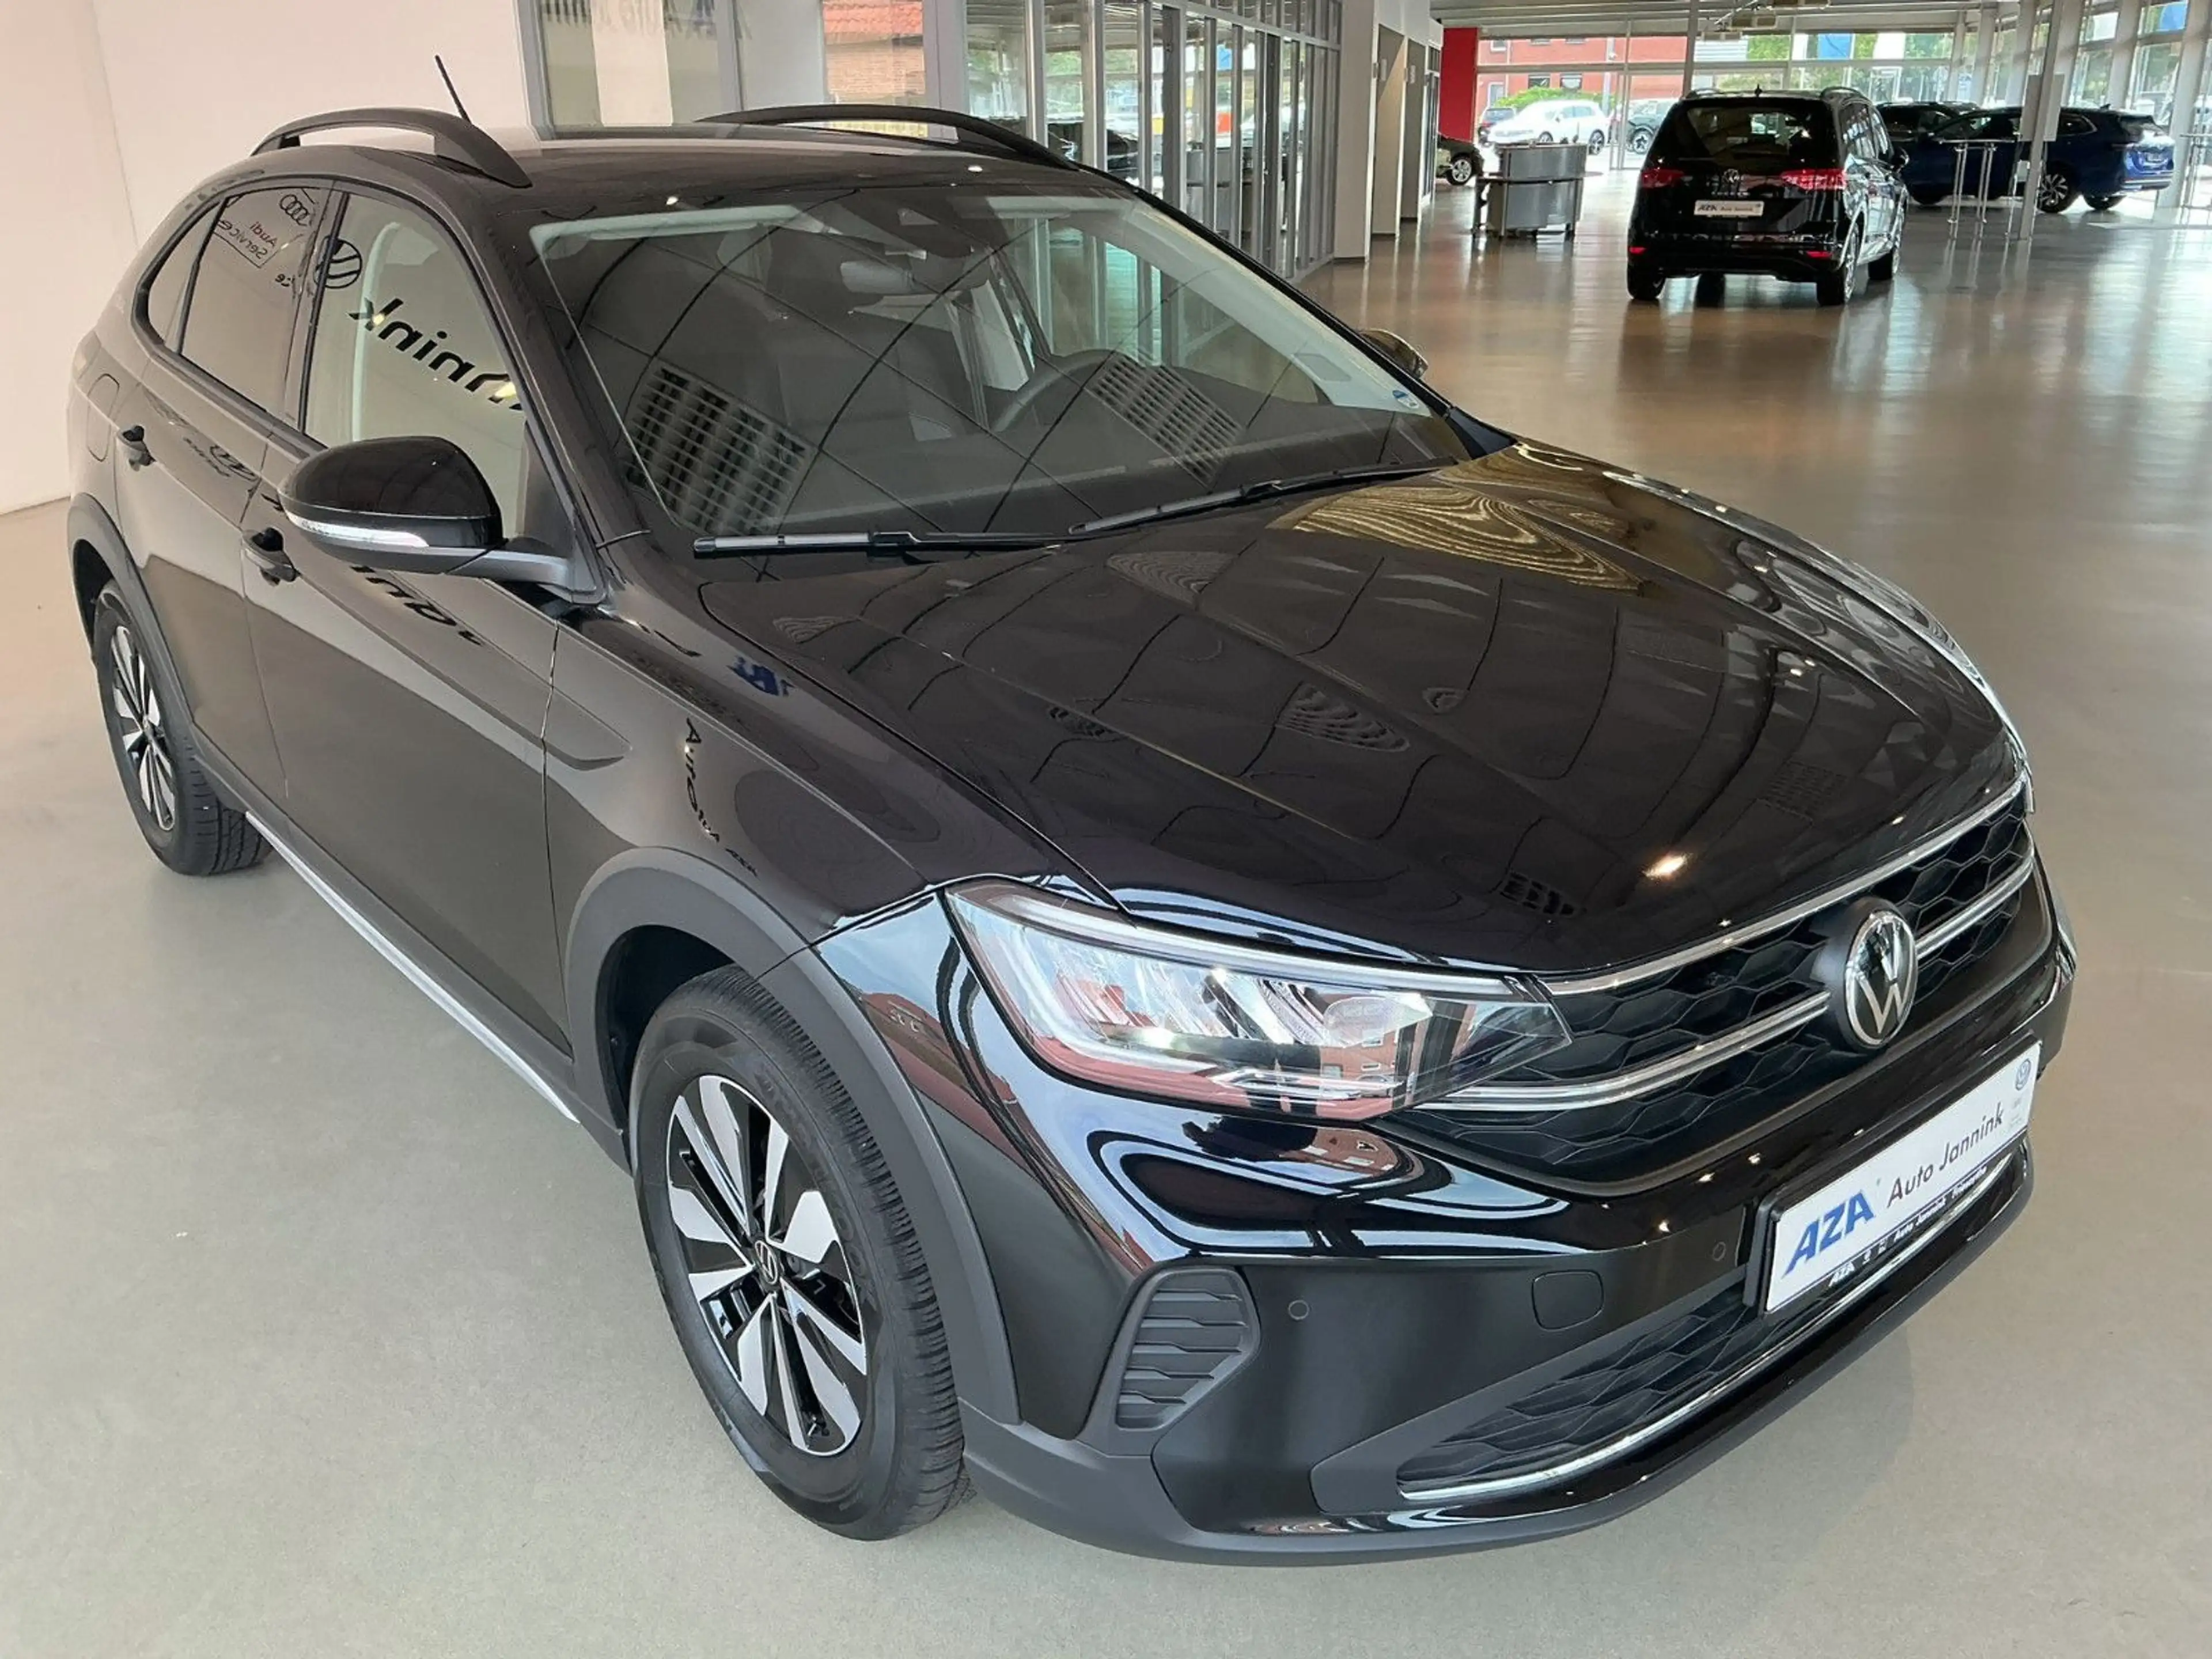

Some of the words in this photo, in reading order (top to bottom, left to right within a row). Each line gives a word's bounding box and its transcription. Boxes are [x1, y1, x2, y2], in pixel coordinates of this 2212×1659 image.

[1782, 1190, 1876, 1279] AZA
[1887, 1163, 1934, 1209] Auto
[1939, 1102, 2004, 1172] Jannink
